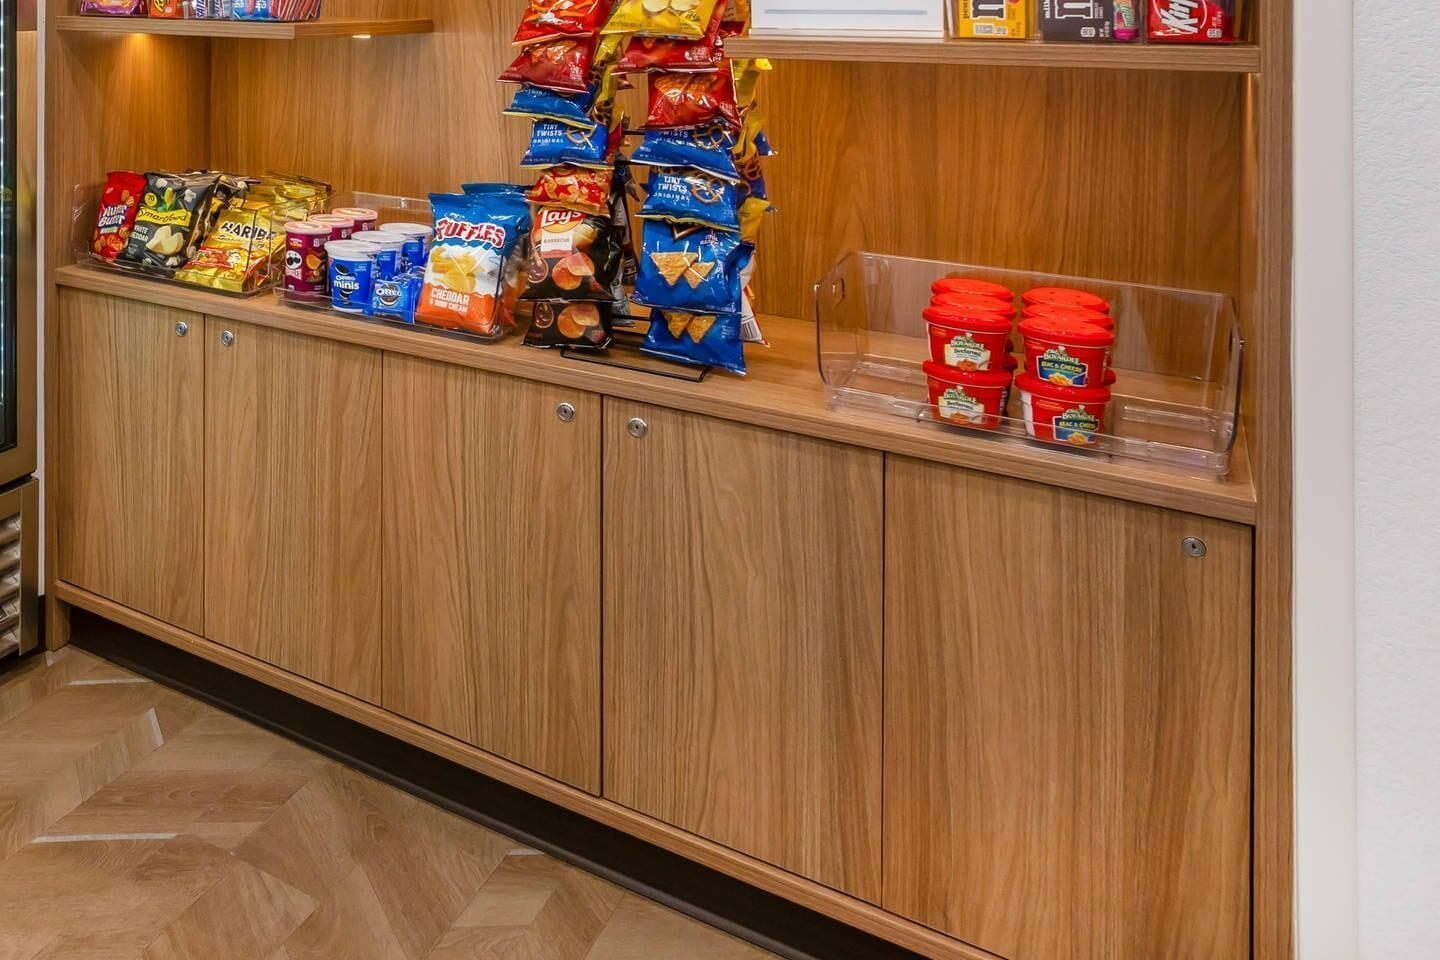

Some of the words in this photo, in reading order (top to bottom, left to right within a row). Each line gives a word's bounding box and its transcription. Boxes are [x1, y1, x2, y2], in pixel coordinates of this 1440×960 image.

[536, 130, 563, 138] TWISTS
[533, 137, 564, 145] ORIGINAL
[663, 175, 681, 185] TINY
[658, 183, 688, 193] TWISTS
[103, 204, 127, 217] Nutter
[138, 207, 188, 222] Smartfood
[98, 214, 126, 228] Butter
[541, 208, 582, 226] Lay's
[437, 219, 505, 248] RUFFLES
[334, 280, 360, 290] minis
[376, 287, 403, 297] OREO
[431, 287, 470, 305] CHEDDAR
[448, 302, 468, 314] CREAM
